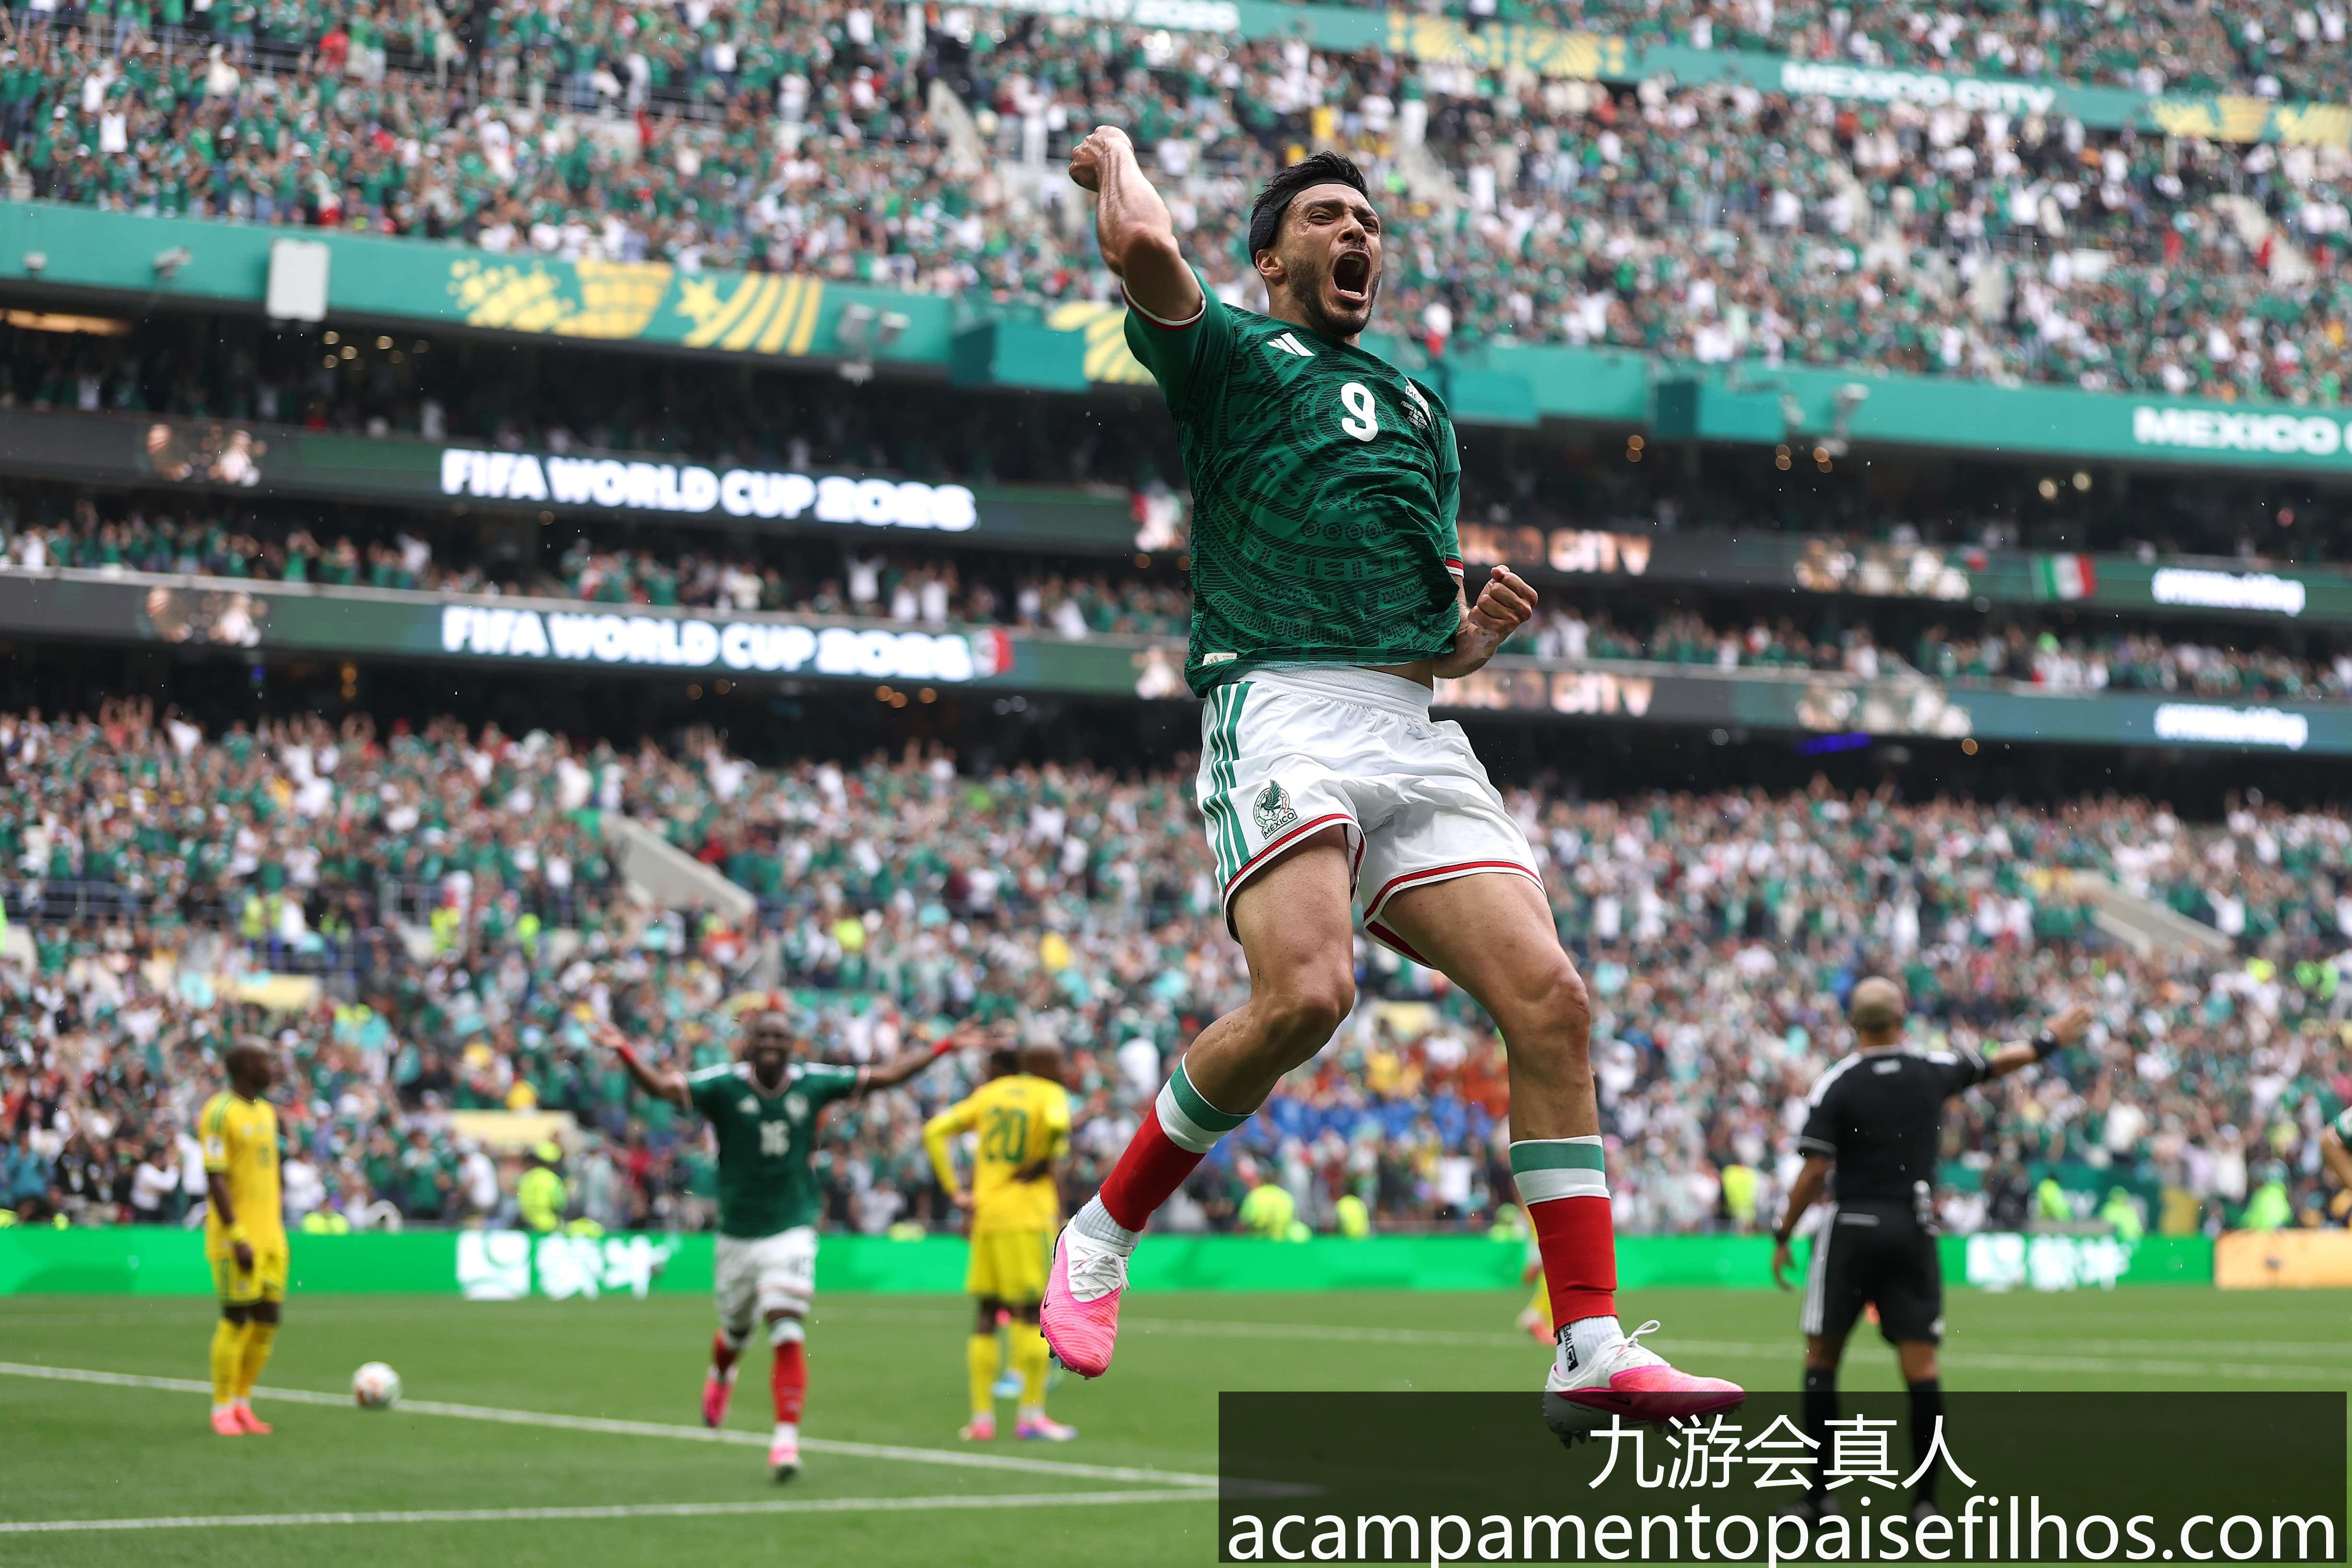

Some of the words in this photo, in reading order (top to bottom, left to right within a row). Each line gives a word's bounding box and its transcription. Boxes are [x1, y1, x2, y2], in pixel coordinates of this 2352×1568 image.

[1780, 62, 1951, 106] MEXICO
[1954, 78, 2056, 115] CITY
[1341, 382, 1378, 442] 9
[2132, 406, 2343, 456] MEXICO
[442, 449, 547, 500] FIFA
[547, 457, 720, 513] WORLD
[721, 470, 816, 519] CUP
[815, 476, 977, 532] 2026
[443, 606, 548, 655] FIFA
[548, 612, 721, 667] WORLD
[722, 624, 817, 671] CUP
[759, 1119, 790, 1156] 16
[985, 1106, 1027, 1163] 20
